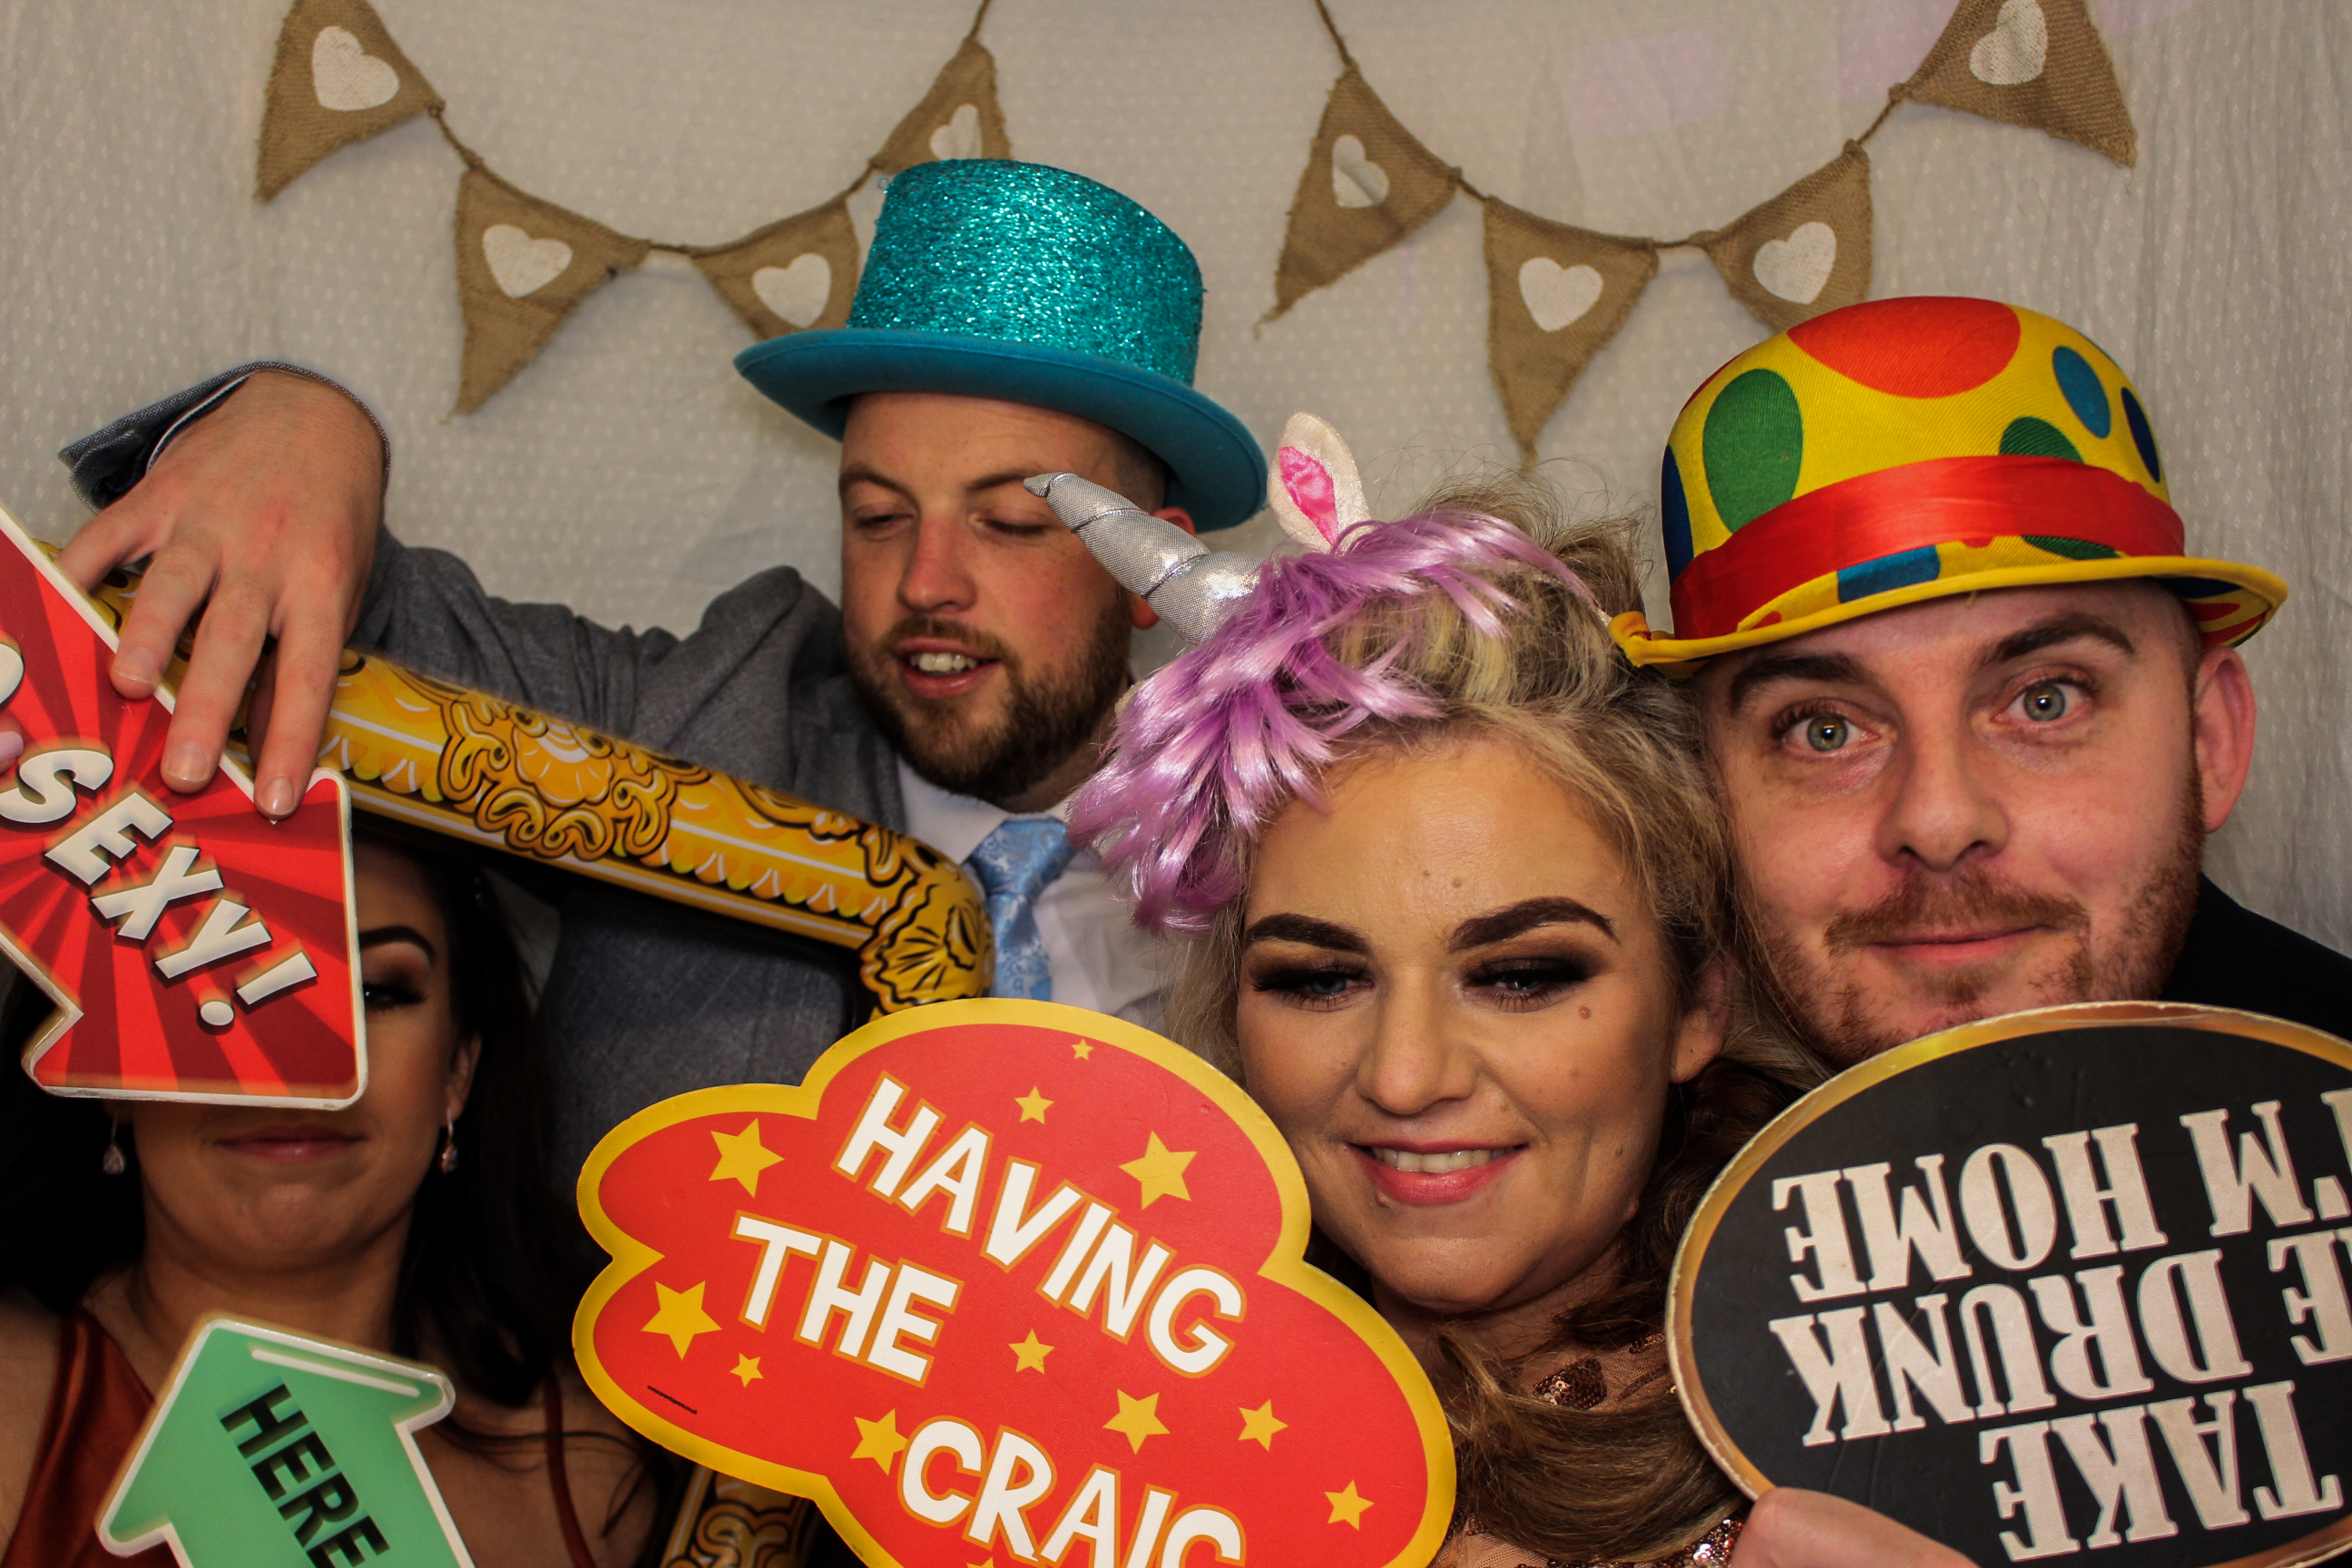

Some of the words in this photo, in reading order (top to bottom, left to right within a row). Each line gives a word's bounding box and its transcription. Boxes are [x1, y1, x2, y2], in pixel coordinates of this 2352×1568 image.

[0, 750, 318, 1026] SEXY!
[736, 1216, 958, 1382] THE
[838, 1077, 1242, 1374] HAVING
[1772, 1122, 2169, 1304] HOME
[2267, 1227, 2352, 1367] E
[1769, 1248, 2254, 1447] DRUNK
[220, 1383, 391, 1568] HERE
[1979, 1381, 2344, 1563] TAKE
